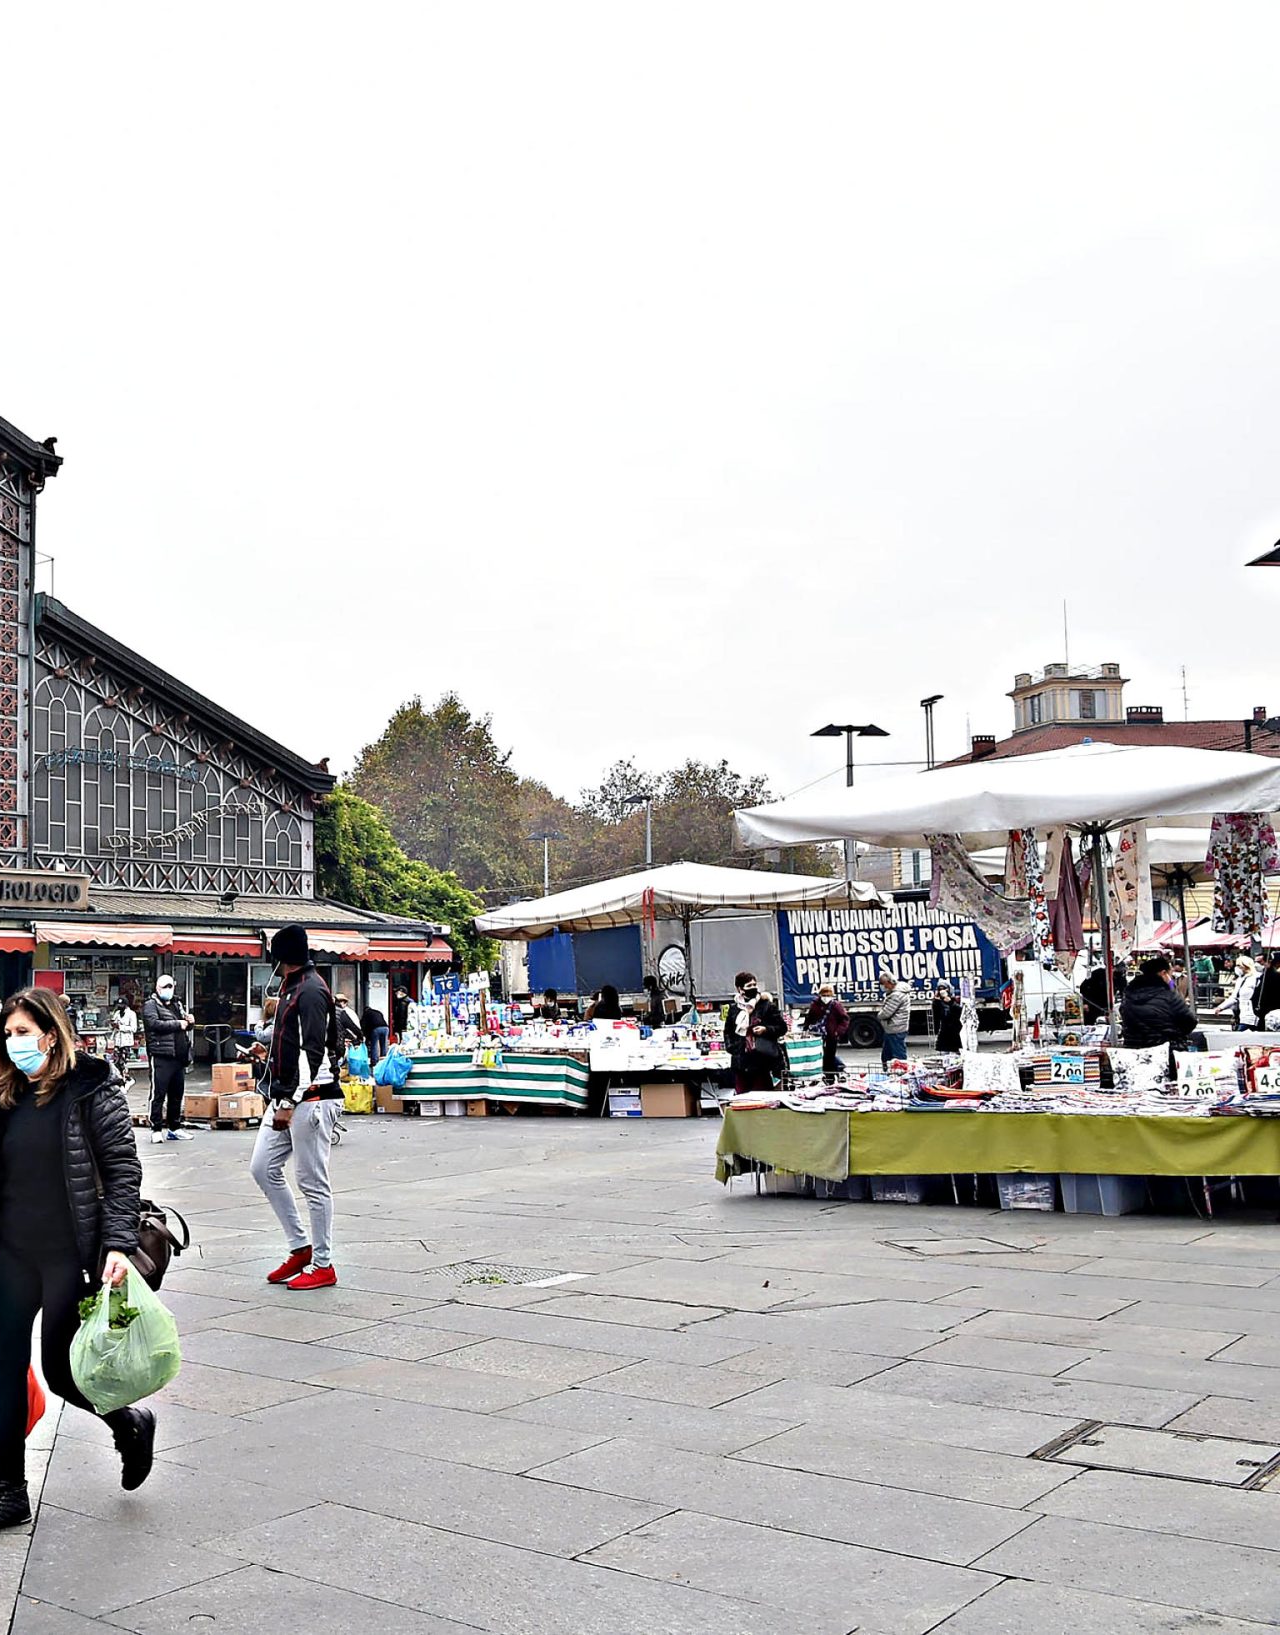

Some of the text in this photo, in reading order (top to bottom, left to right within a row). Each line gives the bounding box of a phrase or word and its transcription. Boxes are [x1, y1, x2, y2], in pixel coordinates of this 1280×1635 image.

[793, 925, 978, 957] INGROSSO E POSA
[795, 956, 853, 984] PREZZI
[855, 954, 876, 981] DI
[878, 951, 939, 980] STOCK
[440, 980, 454, 991] 1€
[923, 979, 932, 990] 5
